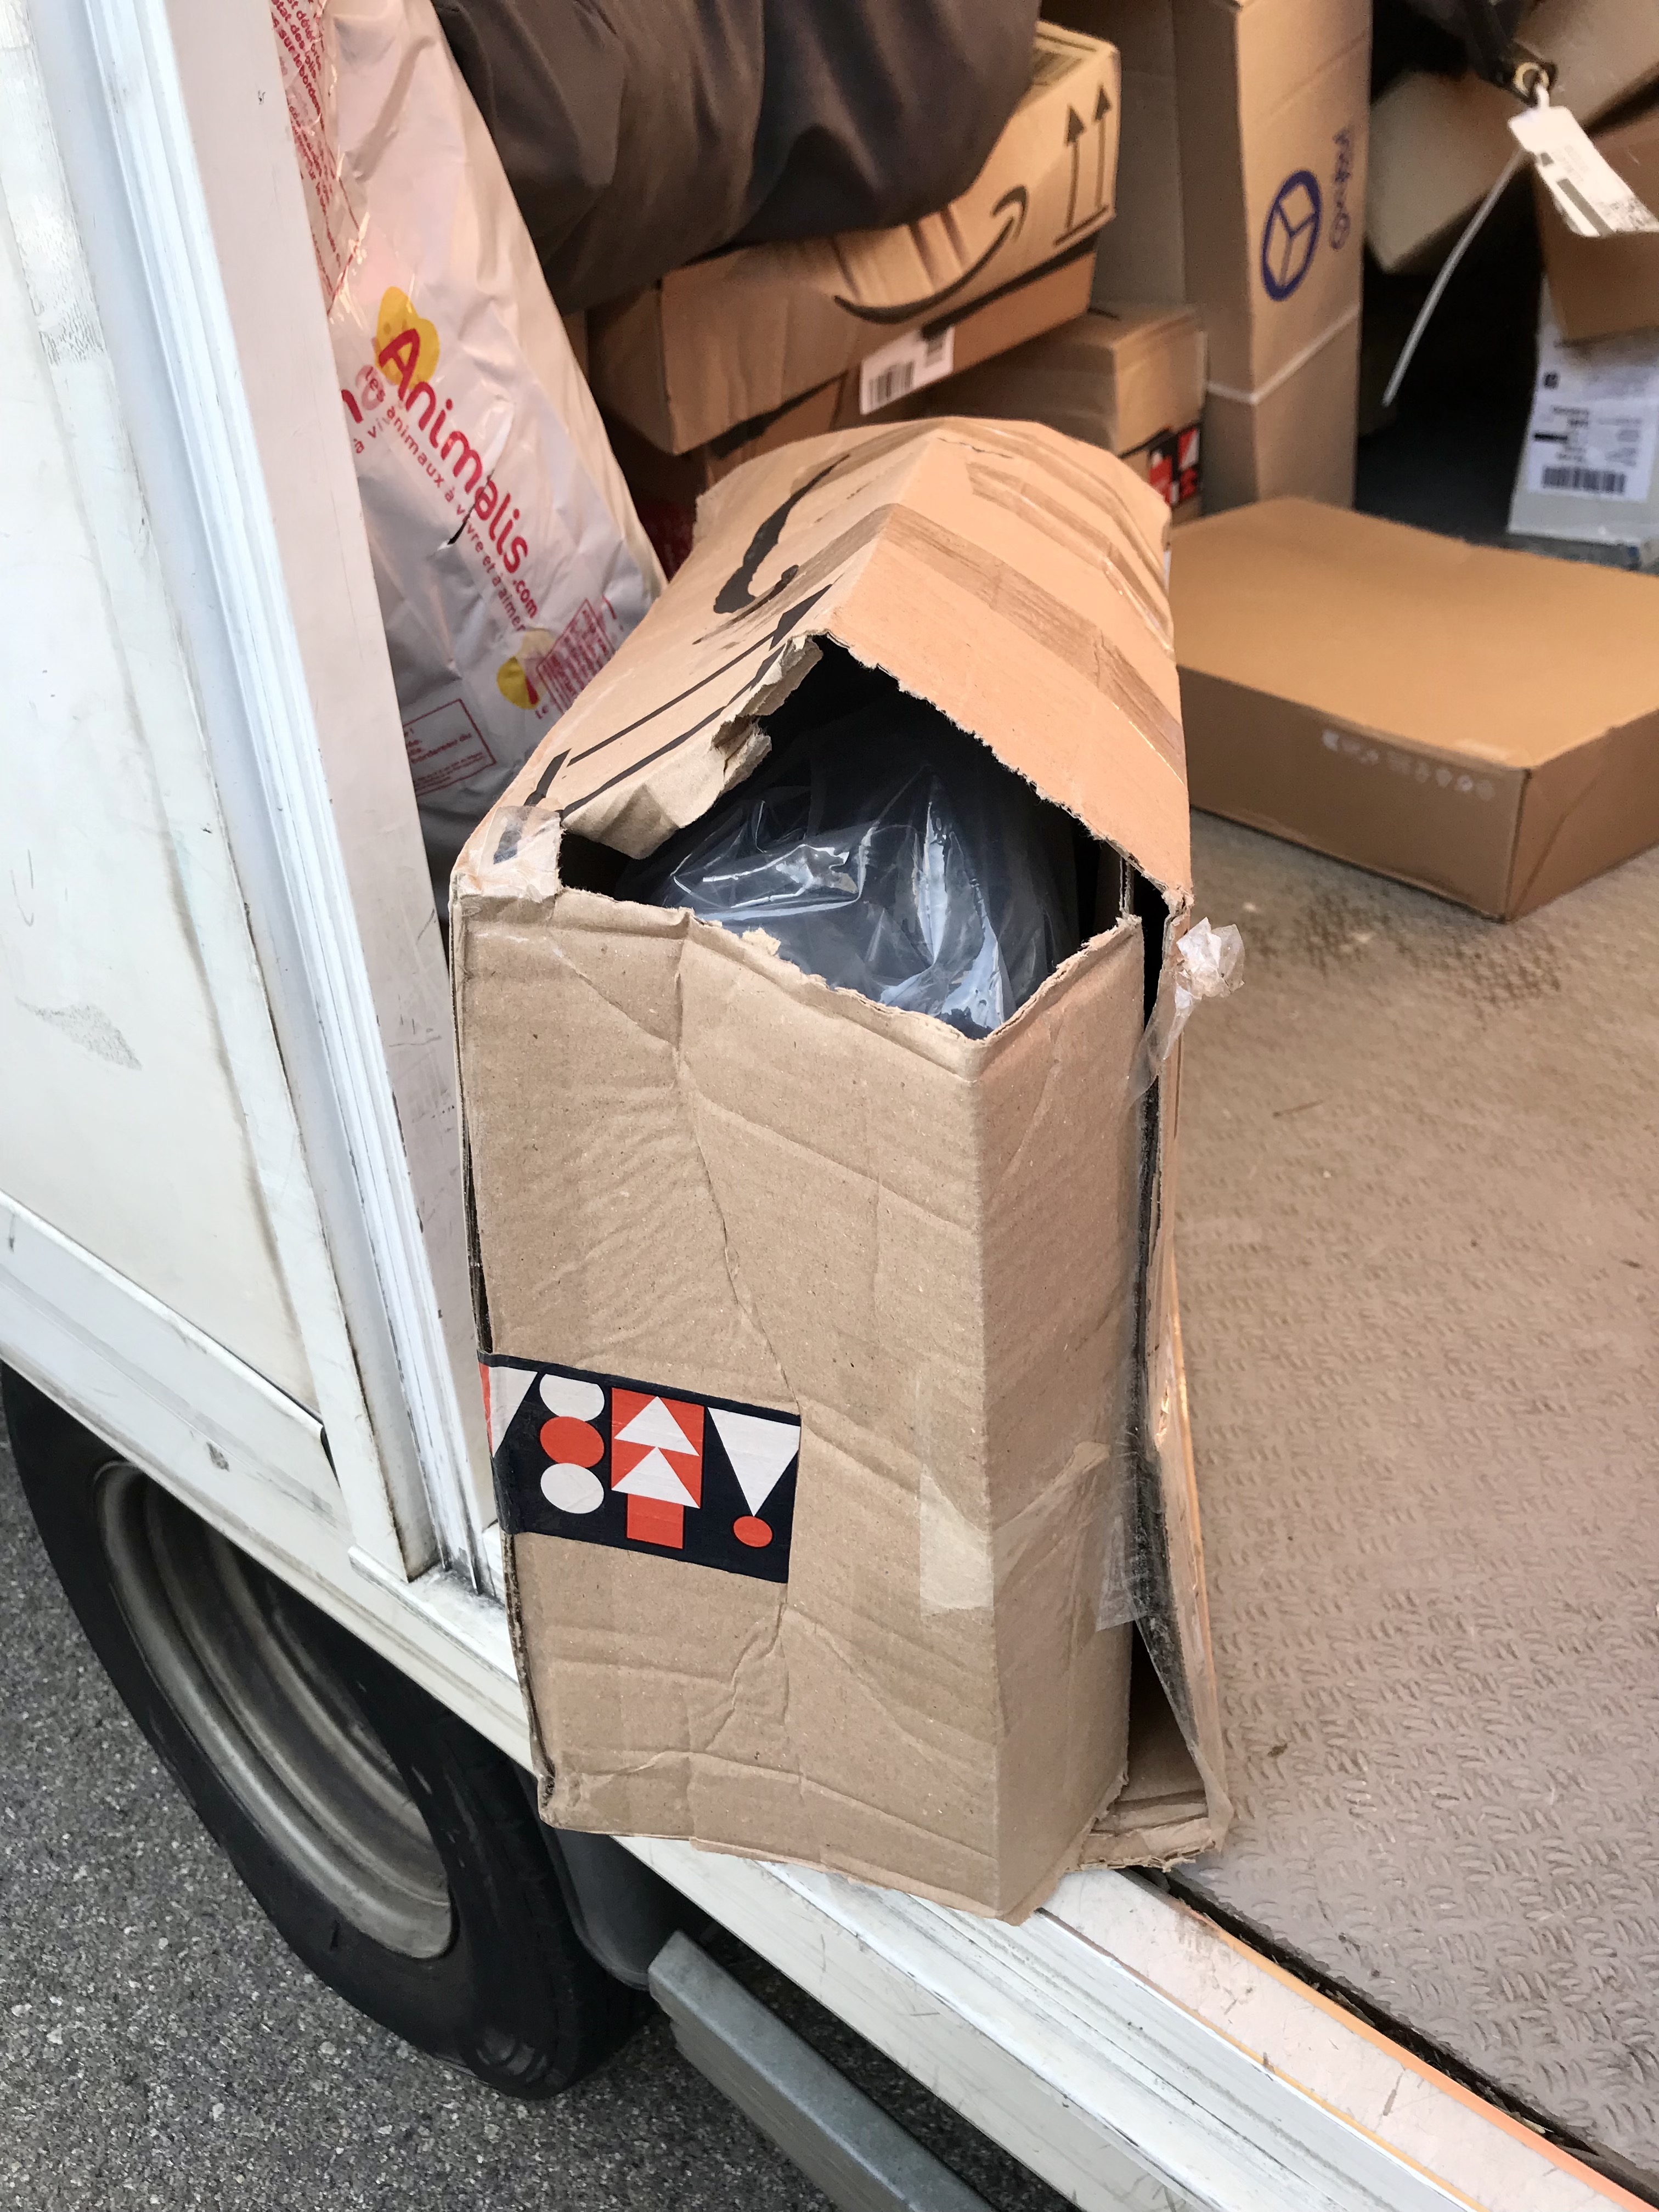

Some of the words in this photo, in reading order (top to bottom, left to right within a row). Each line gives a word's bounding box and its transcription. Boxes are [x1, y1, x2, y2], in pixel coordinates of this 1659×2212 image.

[279, 29, 295, 52] sur
[294, 53, 302, 67] le
[365, 366, 386, 402] les
[386, 406, 444, 488] animaux
[444, 486, 455, 502] à
[482, 555, 496, 573] et
[498, 588, 526, 631] aimer
[378, 328, 528, 573] Animalis
